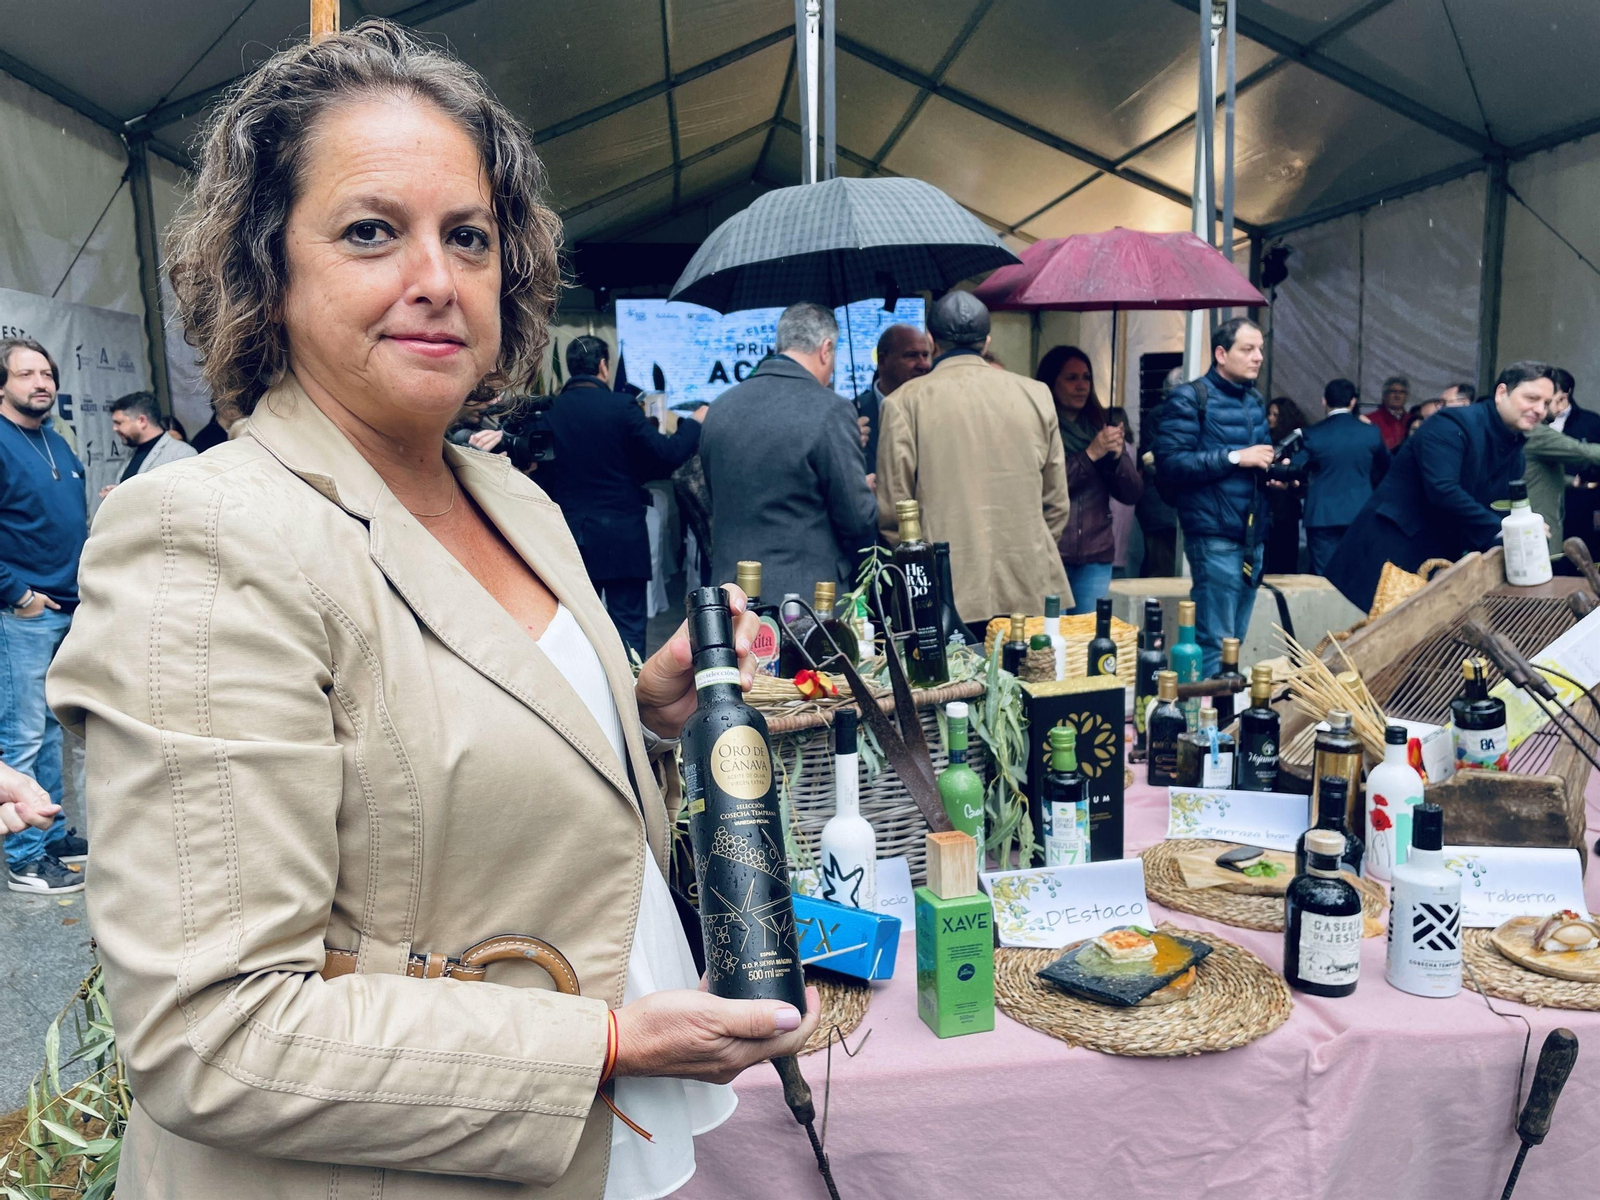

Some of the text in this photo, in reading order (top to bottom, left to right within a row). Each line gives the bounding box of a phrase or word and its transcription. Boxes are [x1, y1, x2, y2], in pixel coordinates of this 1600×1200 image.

[905, 563, 926, 577] HE
[718, 744, 765, 758] ORO DE
[719, 757, 768, 773] CÁNAVA
[720, 812, 750, 820] COSECHA
[942, 912, 988, 934] XAVE
[748, 968, 775, 981] 500 ml
